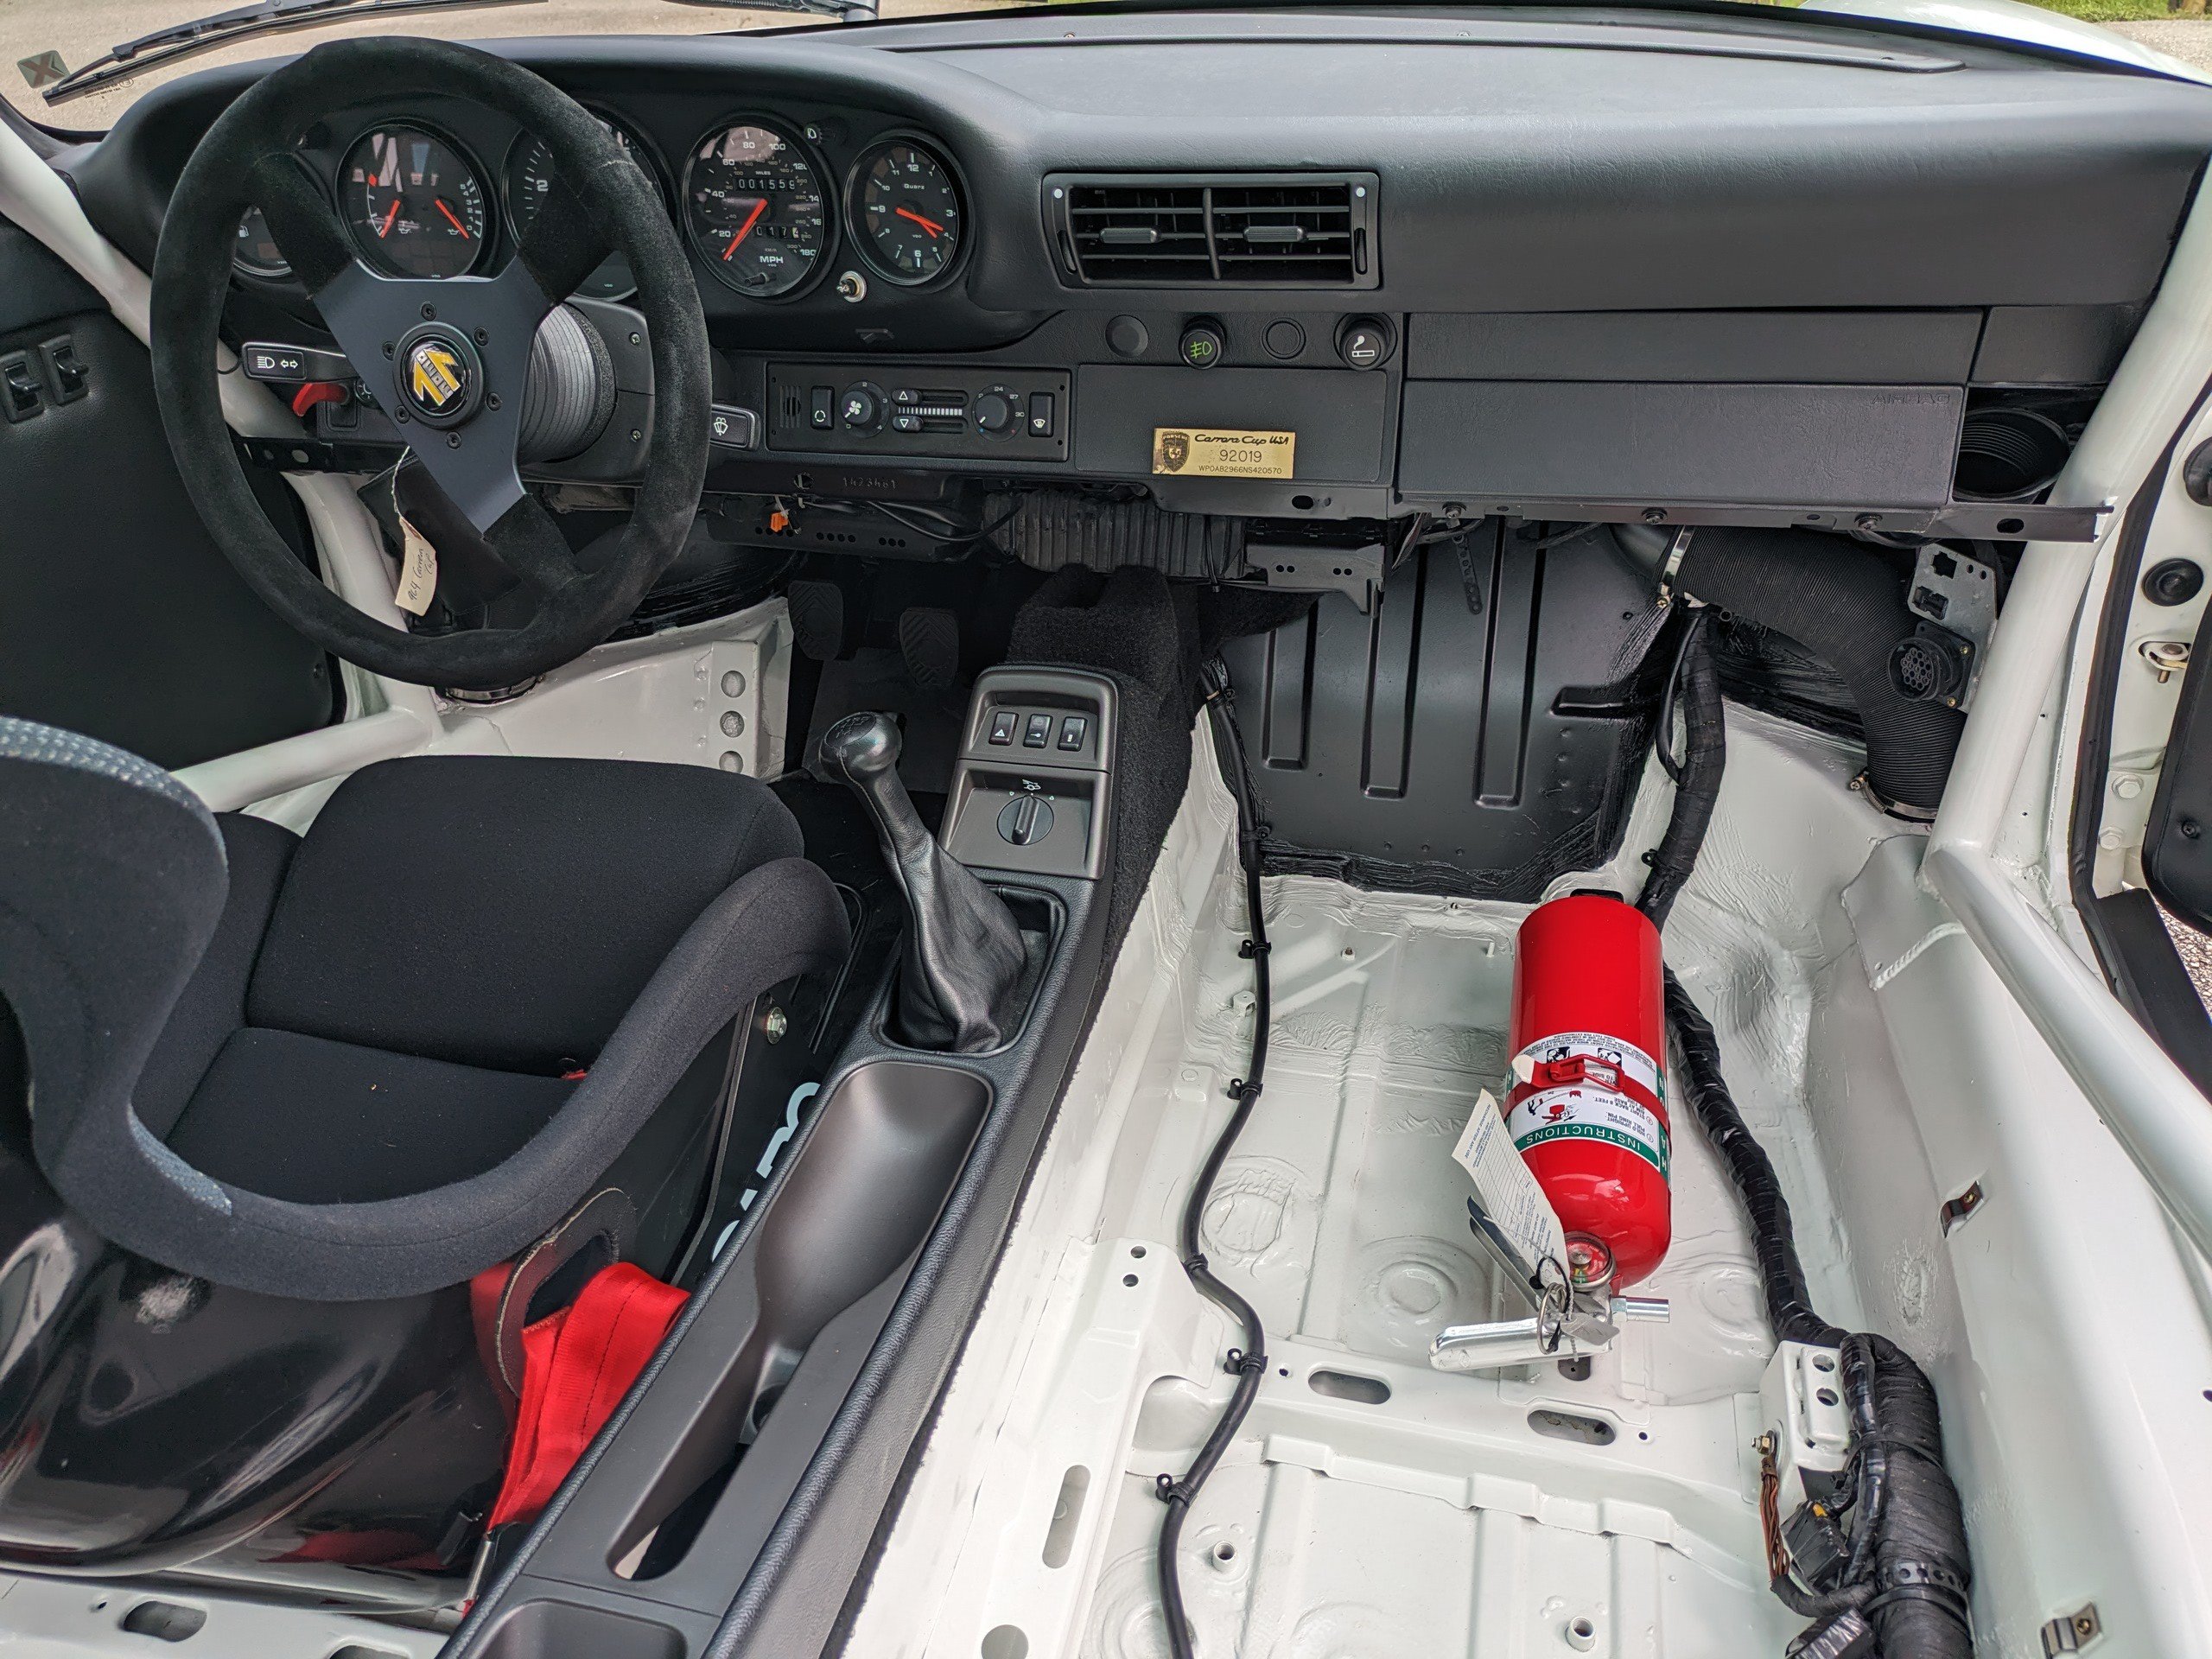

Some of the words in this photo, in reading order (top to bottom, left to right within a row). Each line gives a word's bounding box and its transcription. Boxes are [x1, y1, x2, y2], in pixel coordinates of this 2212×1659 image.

[536, 179, 549, 192] 2
[1194, 434, 1241, 445] Carrera
[1242, 435, 1268, 445] Cup
[1269, 435, 1289, 445] USA
[1219, 449, 1262, 462] 92019
[1526, 1126, 1641, 1151] INSTRUCTIONS
